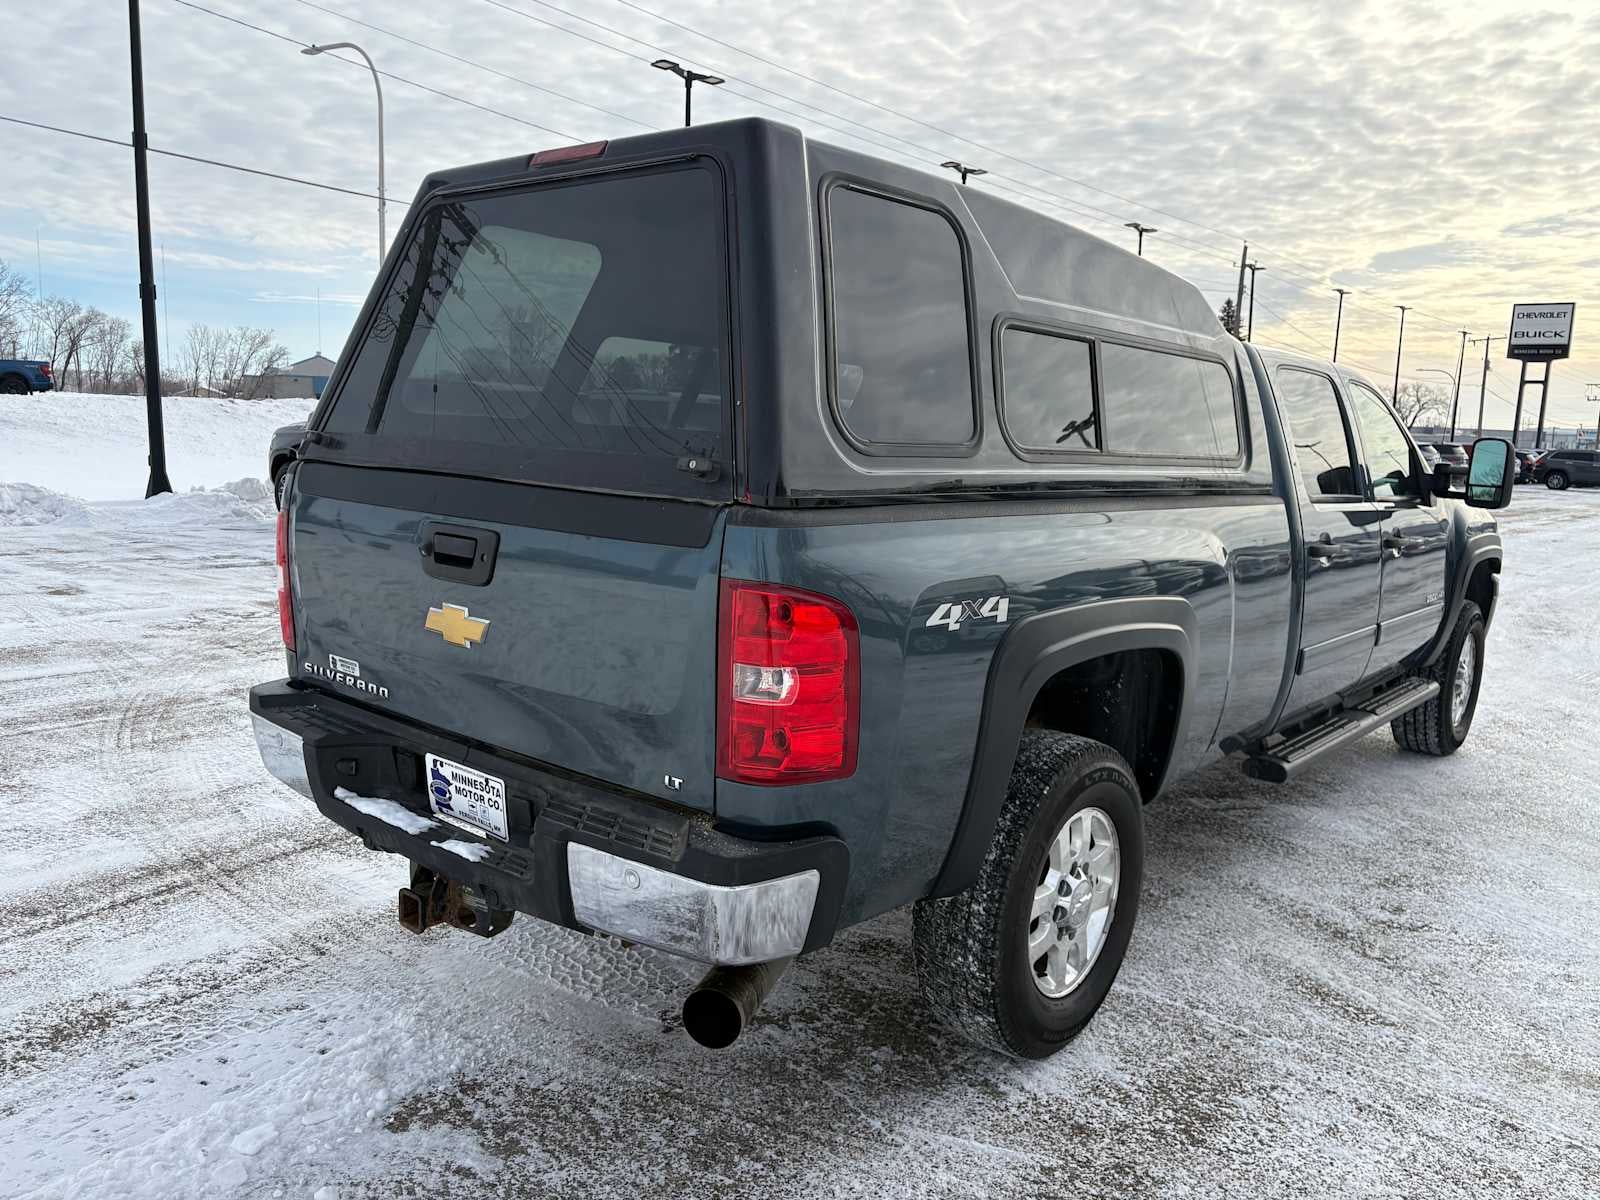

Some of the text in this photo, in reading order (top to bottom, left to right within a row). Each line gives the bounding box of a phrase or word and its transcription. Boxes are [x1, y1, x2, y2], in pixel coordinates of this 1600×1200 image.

[1514, 330, 1566, 339] BUICK
[304, 662, 389, 698] SILVERADO
[451, 771, 502, 799] MINNESOTA
[664, 775, 683, 790] LT
[454, 785, 486, 805] MOTOR
[487, 796, 503, 812] CO.
